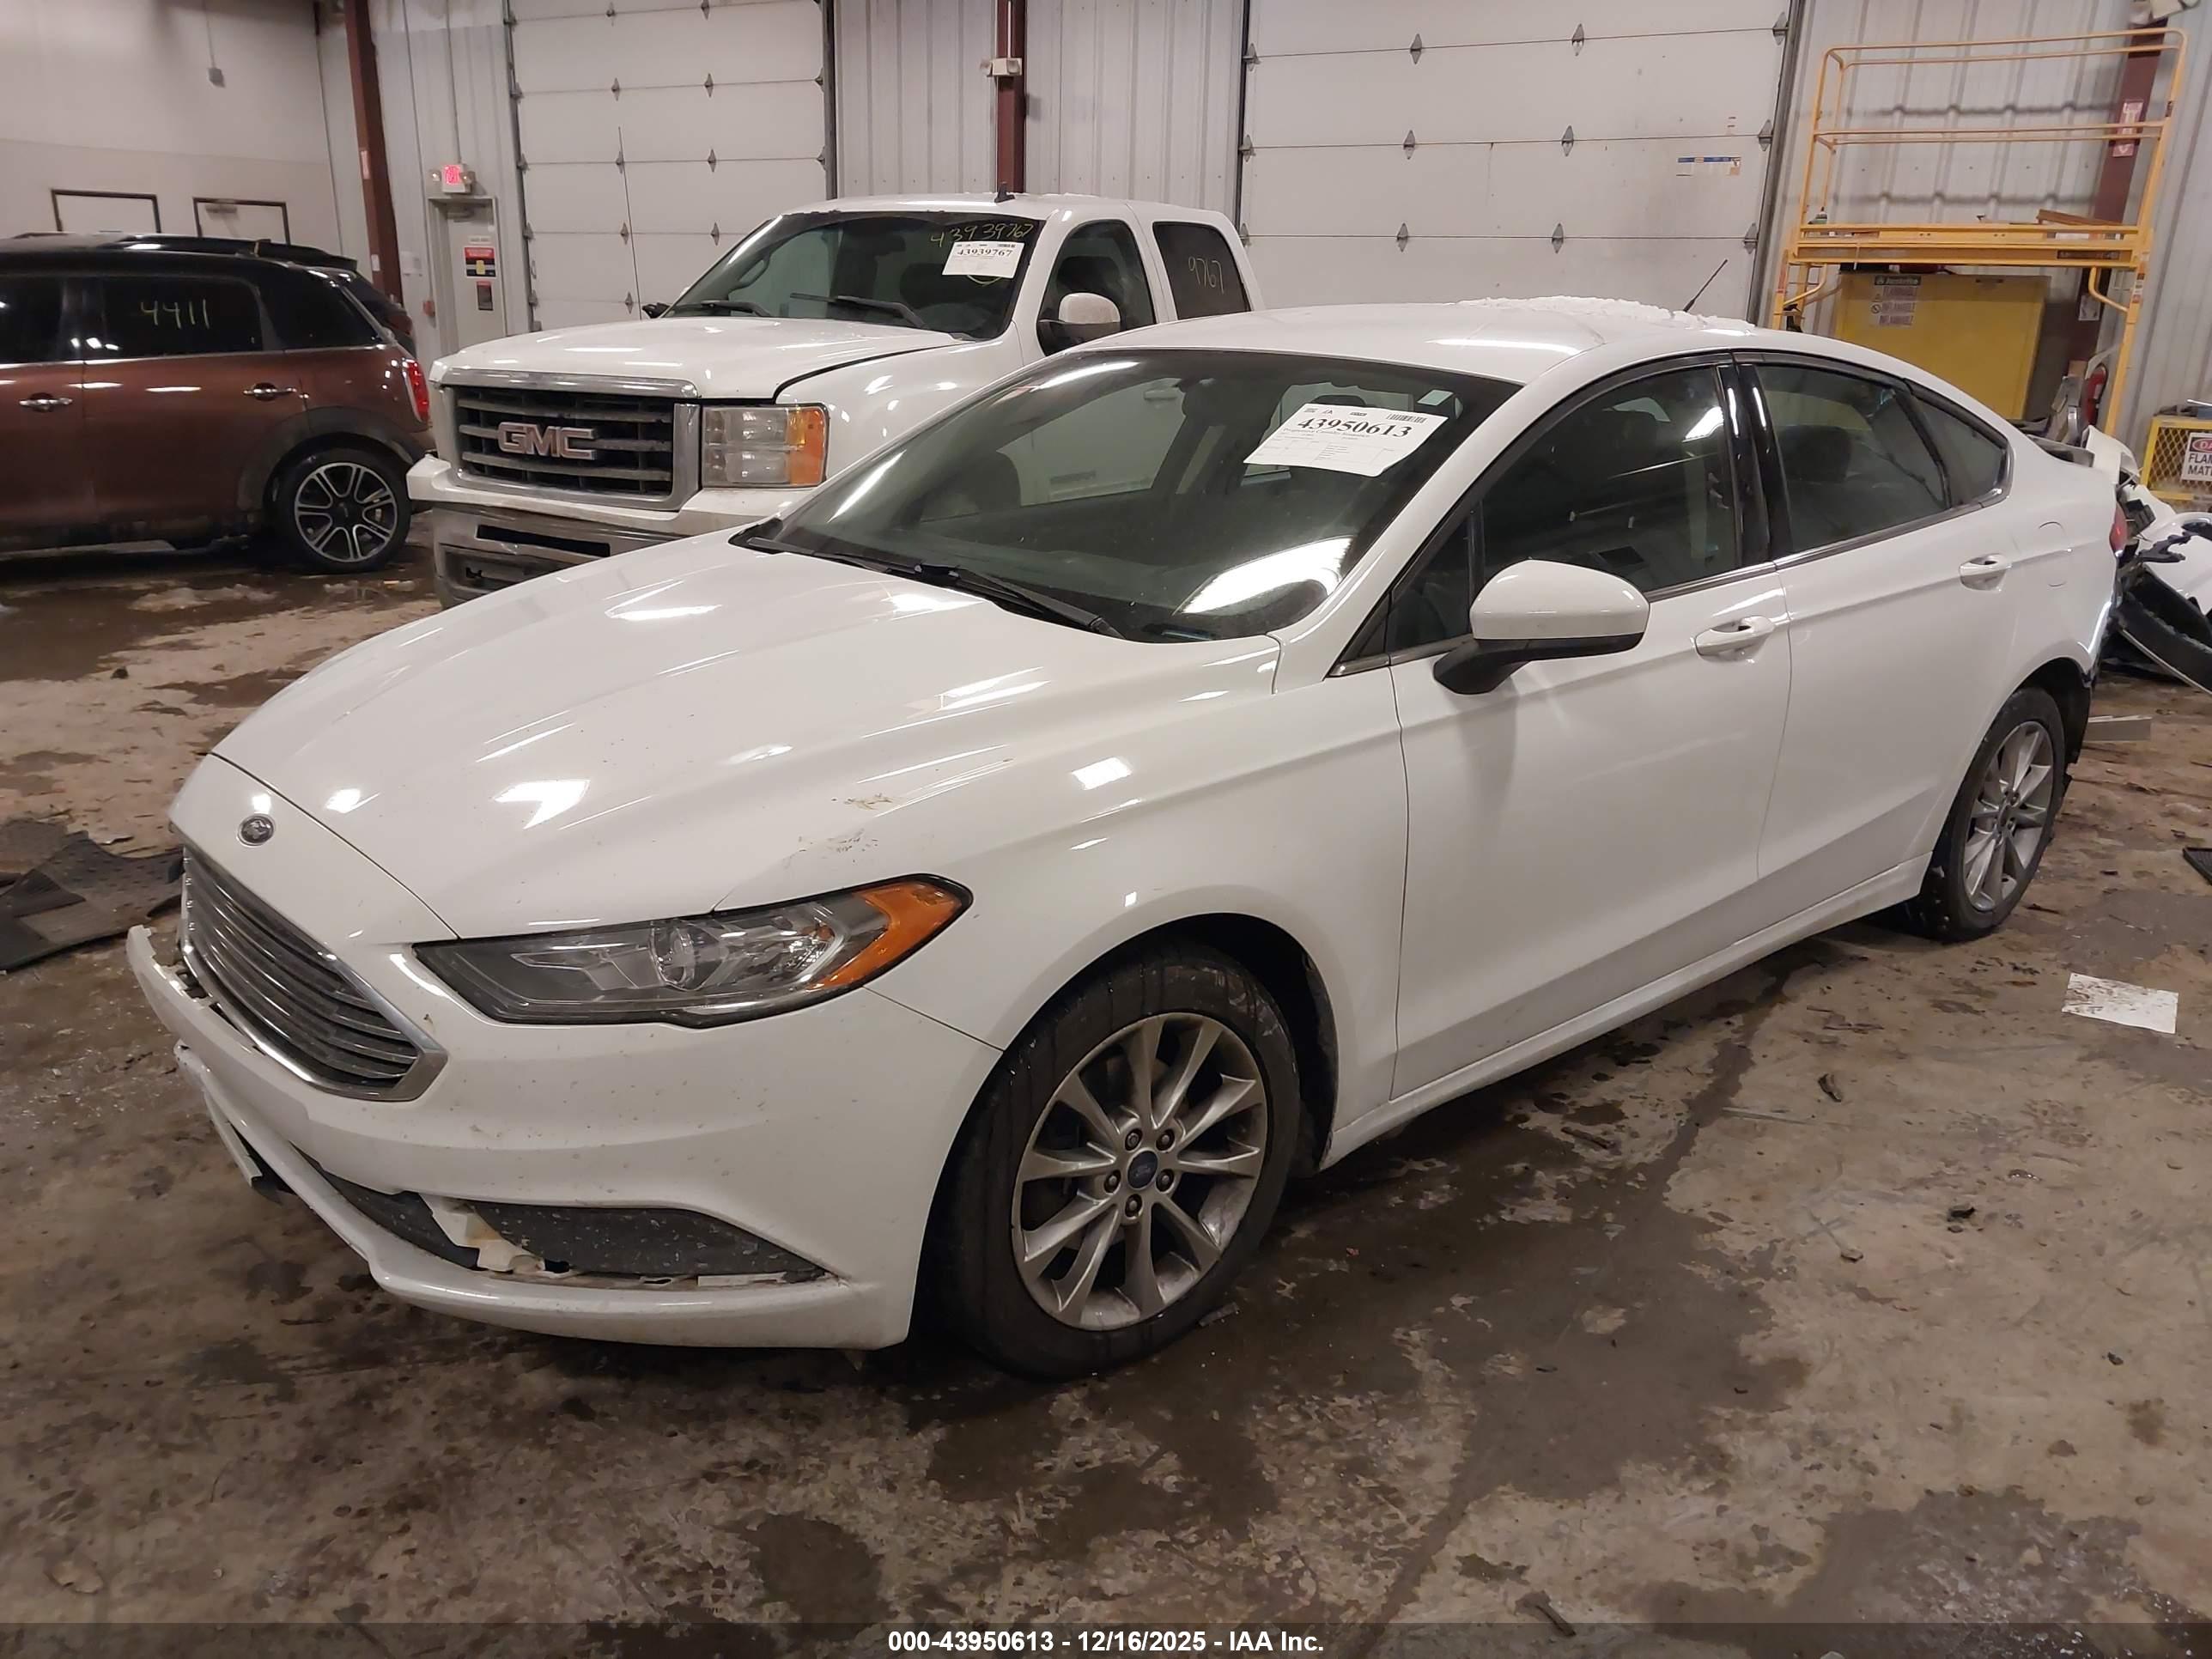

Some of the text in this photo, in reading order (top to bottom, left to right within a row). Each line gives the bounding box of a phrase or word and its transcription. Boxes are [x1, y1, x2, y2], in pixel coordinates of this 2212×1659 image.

[957, 248, 1013, 257] 43939767
[1188, 256, 1224, 294] 9767
[140, 299, 210, 329] 4411
[1297, 417, 1413, 438] 43950613
[498, 422, 598, 460] GMC
[2187, 465, 2212, 477] MAT
